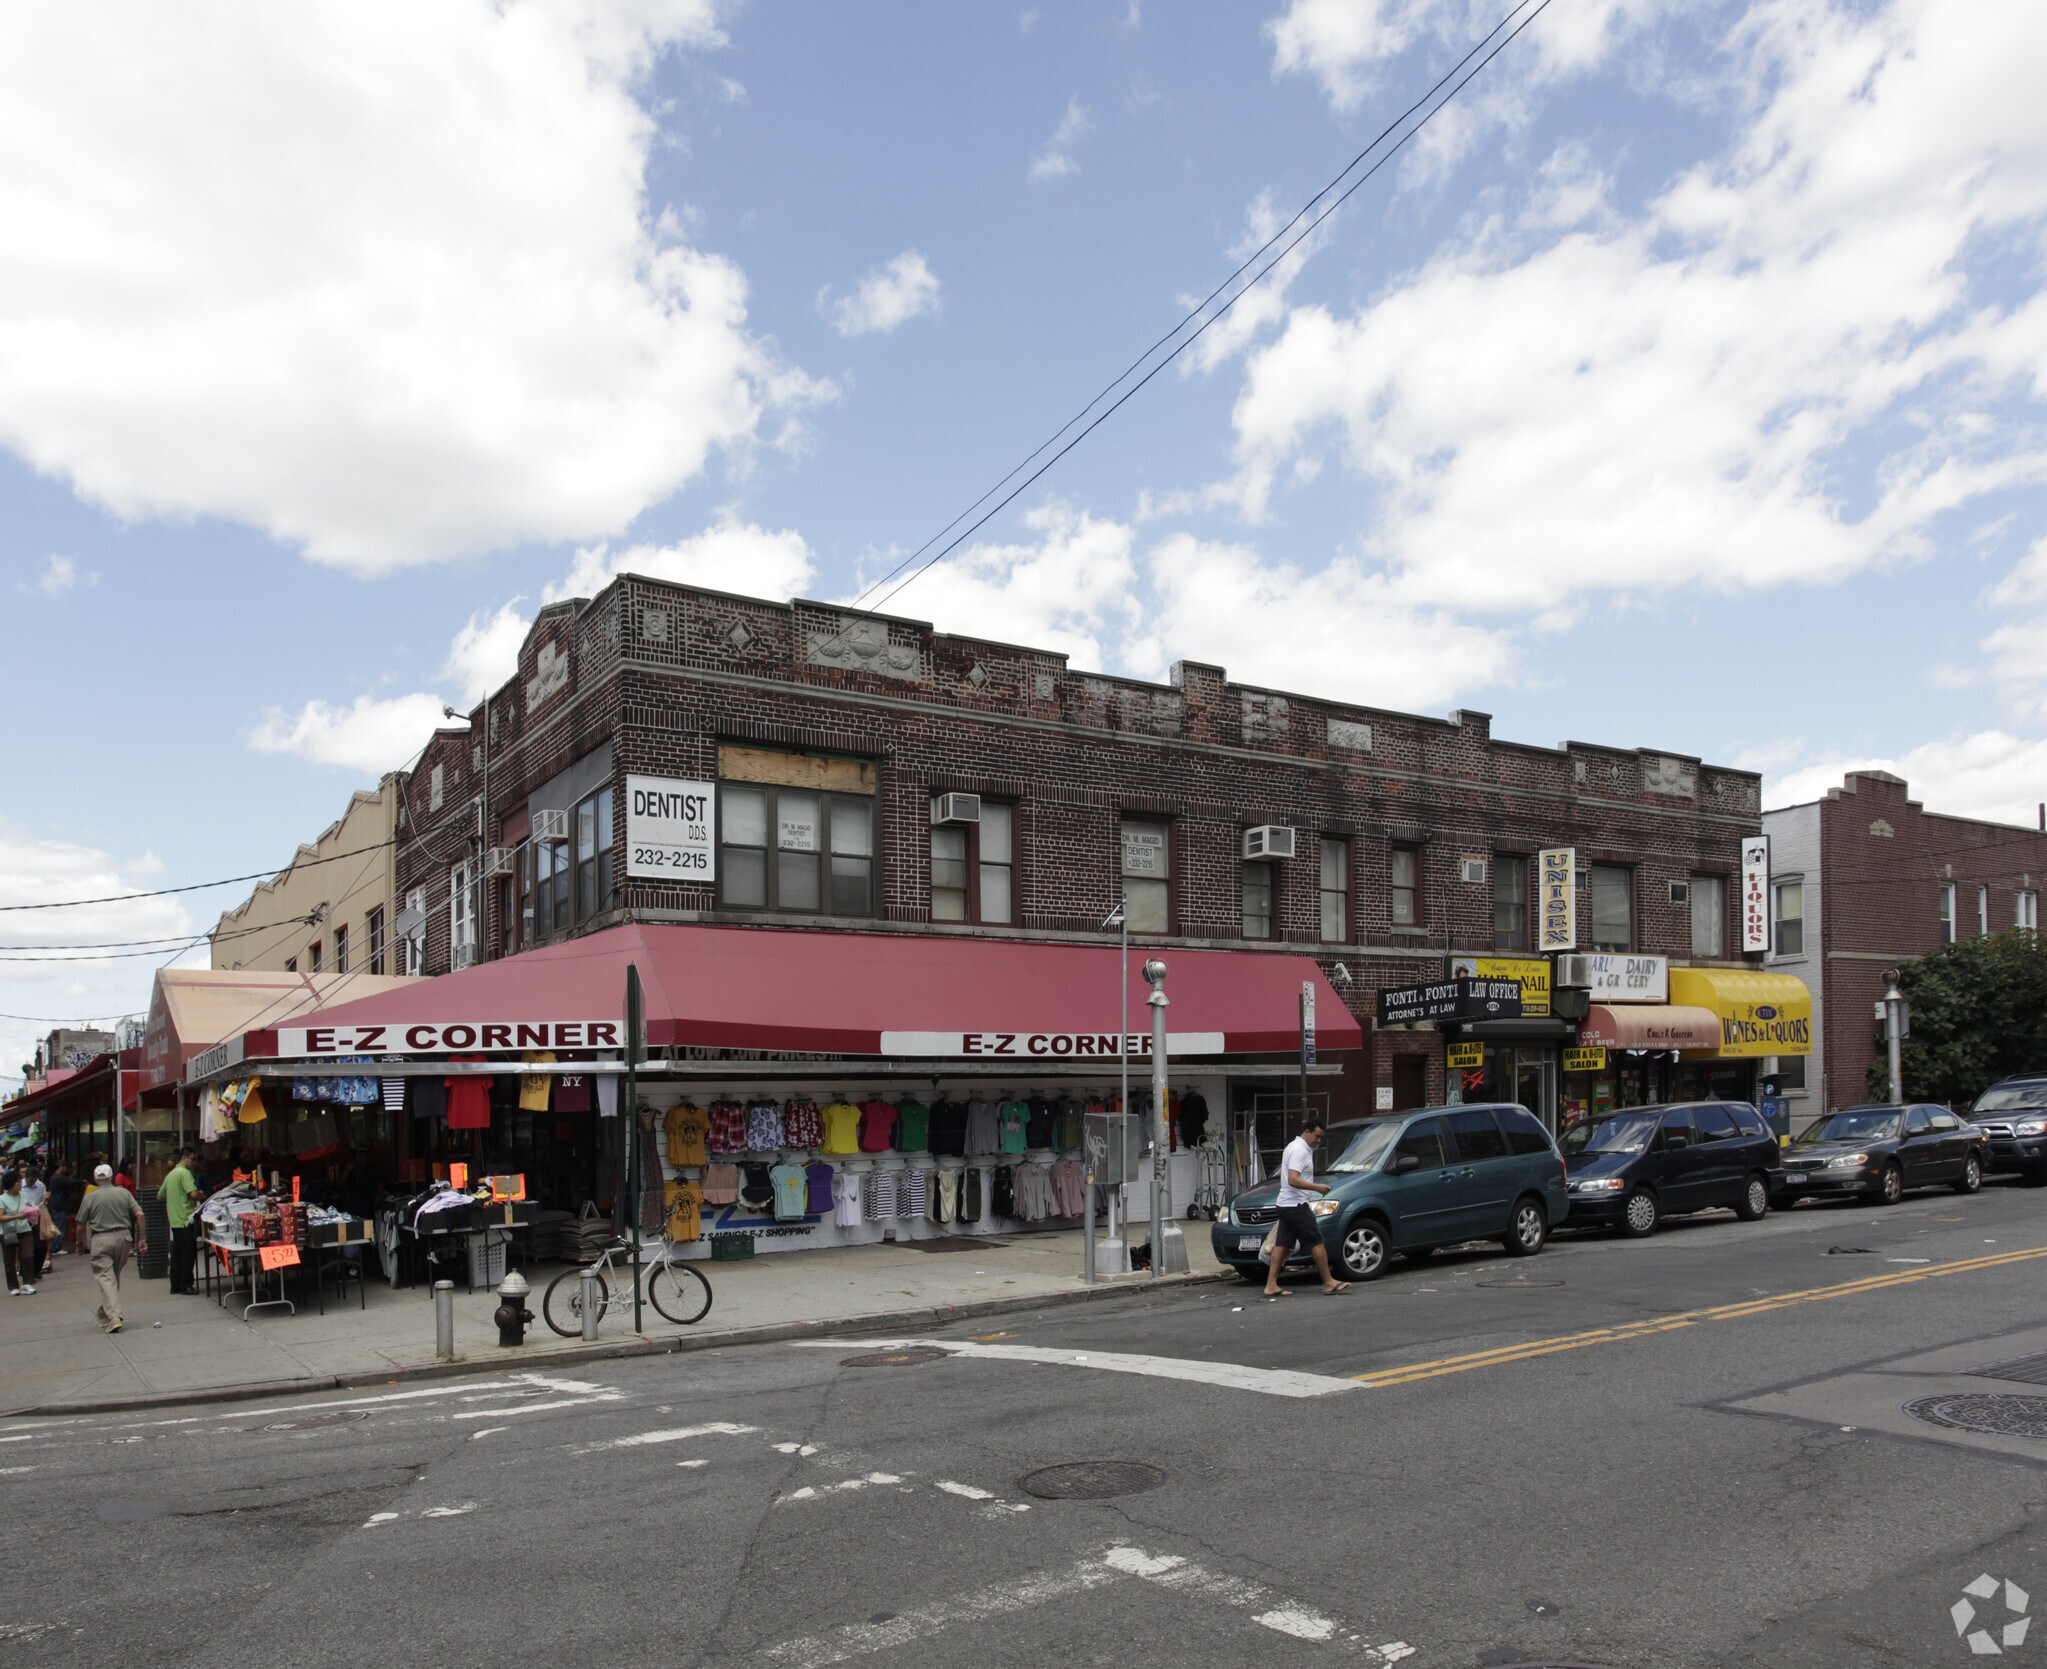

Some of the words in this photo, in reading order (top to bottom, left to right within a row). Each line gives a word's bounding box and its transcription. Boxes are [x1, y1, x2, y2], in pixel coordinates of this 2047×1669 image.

[634, 789, 707, 822] DENTIST
[688, 824, 708, 841] D.D.S.
[787, 829, 806, 837] DENTIST
[782, 839, 811, 848] 232-2215
[1121, 834, 1132, 842] DR.
[1141, 835, 1160, 845] MAGID
[1127, 846, 1153, 857] DENTIST
[634, 848, 708, 869] 232-2215
[1131, 858, 1154, 869] 232-2215
[1543, 853, 1569, 945] UNISEX
[1747, 872, 1763, 945] LIQUORS
[1625, 958, 1659, 975] DAIRY
[1468, 981, 1488, 998] LAW
[1489, 983, 1518, 999] OFFICE
[1520, 975, 1549, 992] NAIL
[1385, 988, 1418, 1007] FONTI
[1425, 983, 1459, 1001] FONTI
[1429, 1005, 1438, 1015] AT
[1439, 1003, 1456, 1013] LAW
[306, 1026, 388, 1053] E-Z
[405, 1022, 618, 1050] CORNER
[1582, 1031, 1600, 1039] COLD
[1759, 1027, 1765, 1041] &
[962, 1033, 1016, 1055] E-Z
[1027, 1033, 1153, 1055] CORNER
[1596, 1038, 1615, 1046] BEER
[660, 1045, 681, 1061] AT
[1449, 1044, 1463, 1057] HAIR
[1463, 1046, 1469, 1055] &
[1564, 1049, 1581, 1060] HAIR
[1582, 1050, 1588, 1059] &
[204, 1044, 228, 1074] CORNER
[1453, 1056, 1478, 1065] SALON
[1570, 1060, 1598, 1069] SALON
[562, 1076, 582, 1087] NY
[1767, 1084, 1774, 1095] P
[750, 1228, 764, 1238] E-Z
